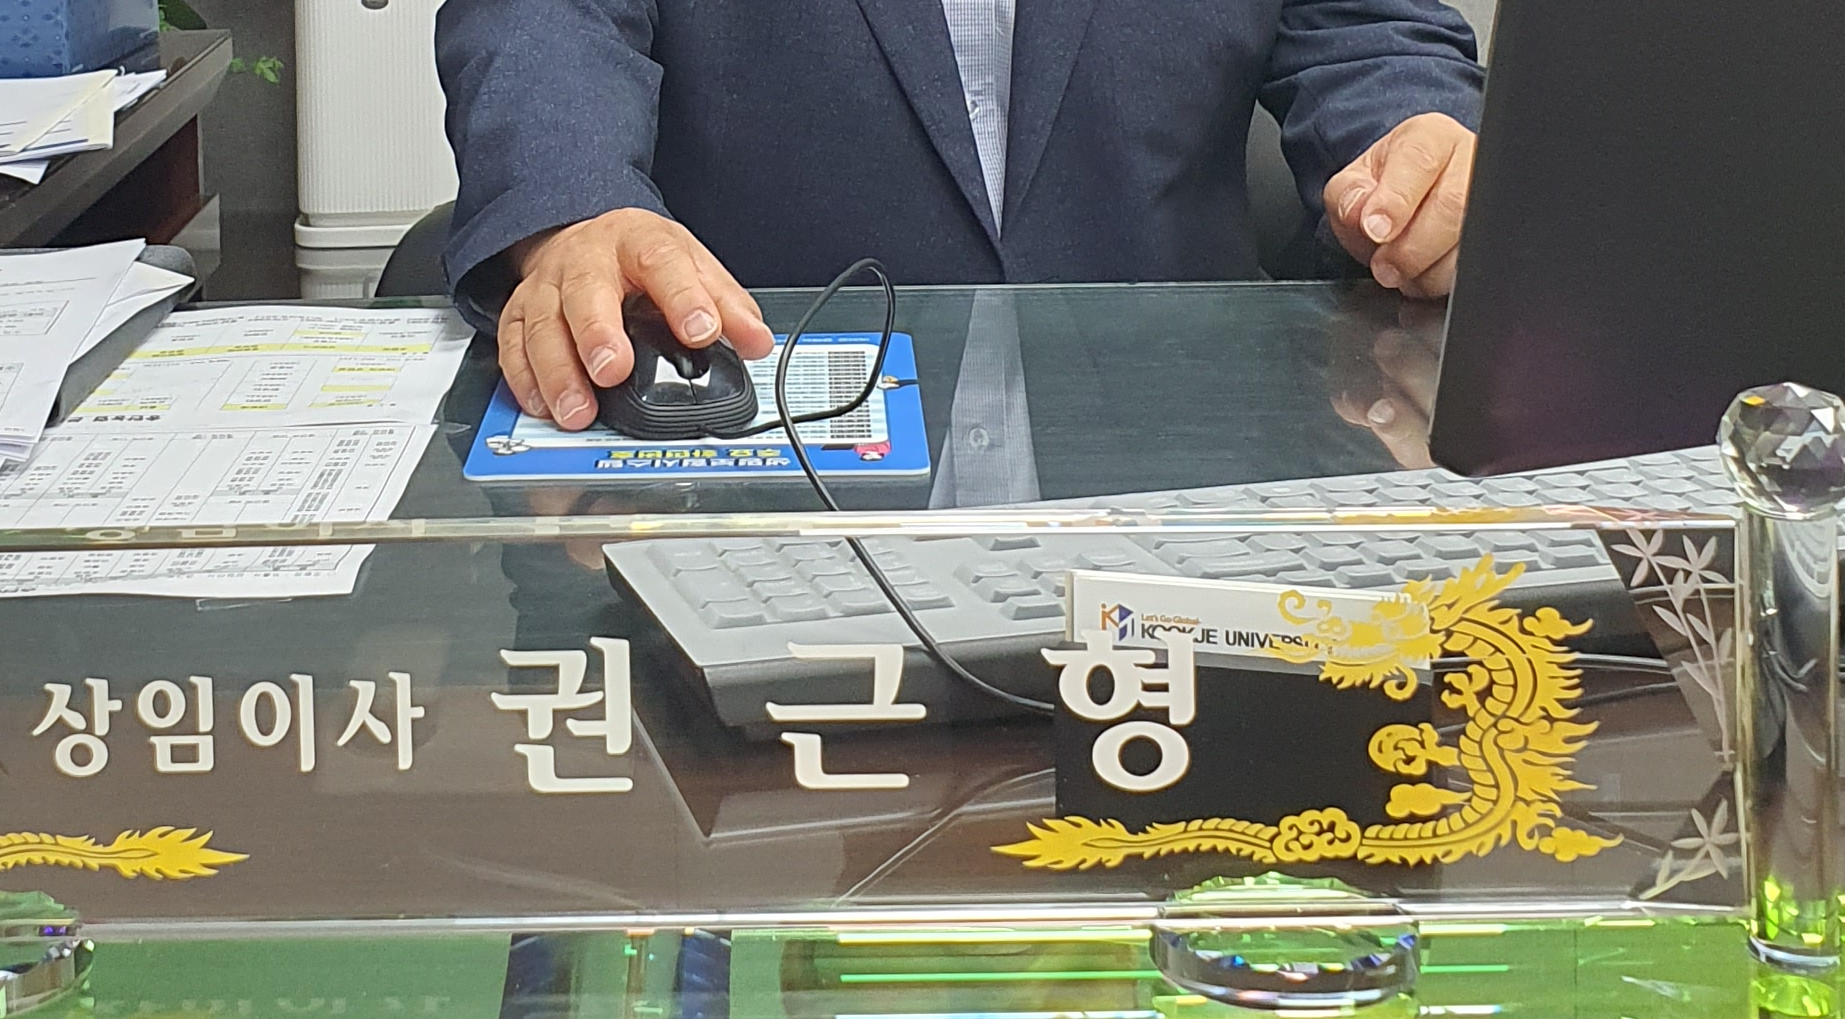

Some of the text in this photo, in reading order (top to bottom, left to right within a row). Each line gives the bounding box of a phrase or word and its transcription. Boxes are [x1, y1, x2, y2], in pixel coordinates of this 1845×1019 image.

[1159, 615, 1172, 623] Go
[32, 630, 1197, 793] 상임이사 권 근 형
